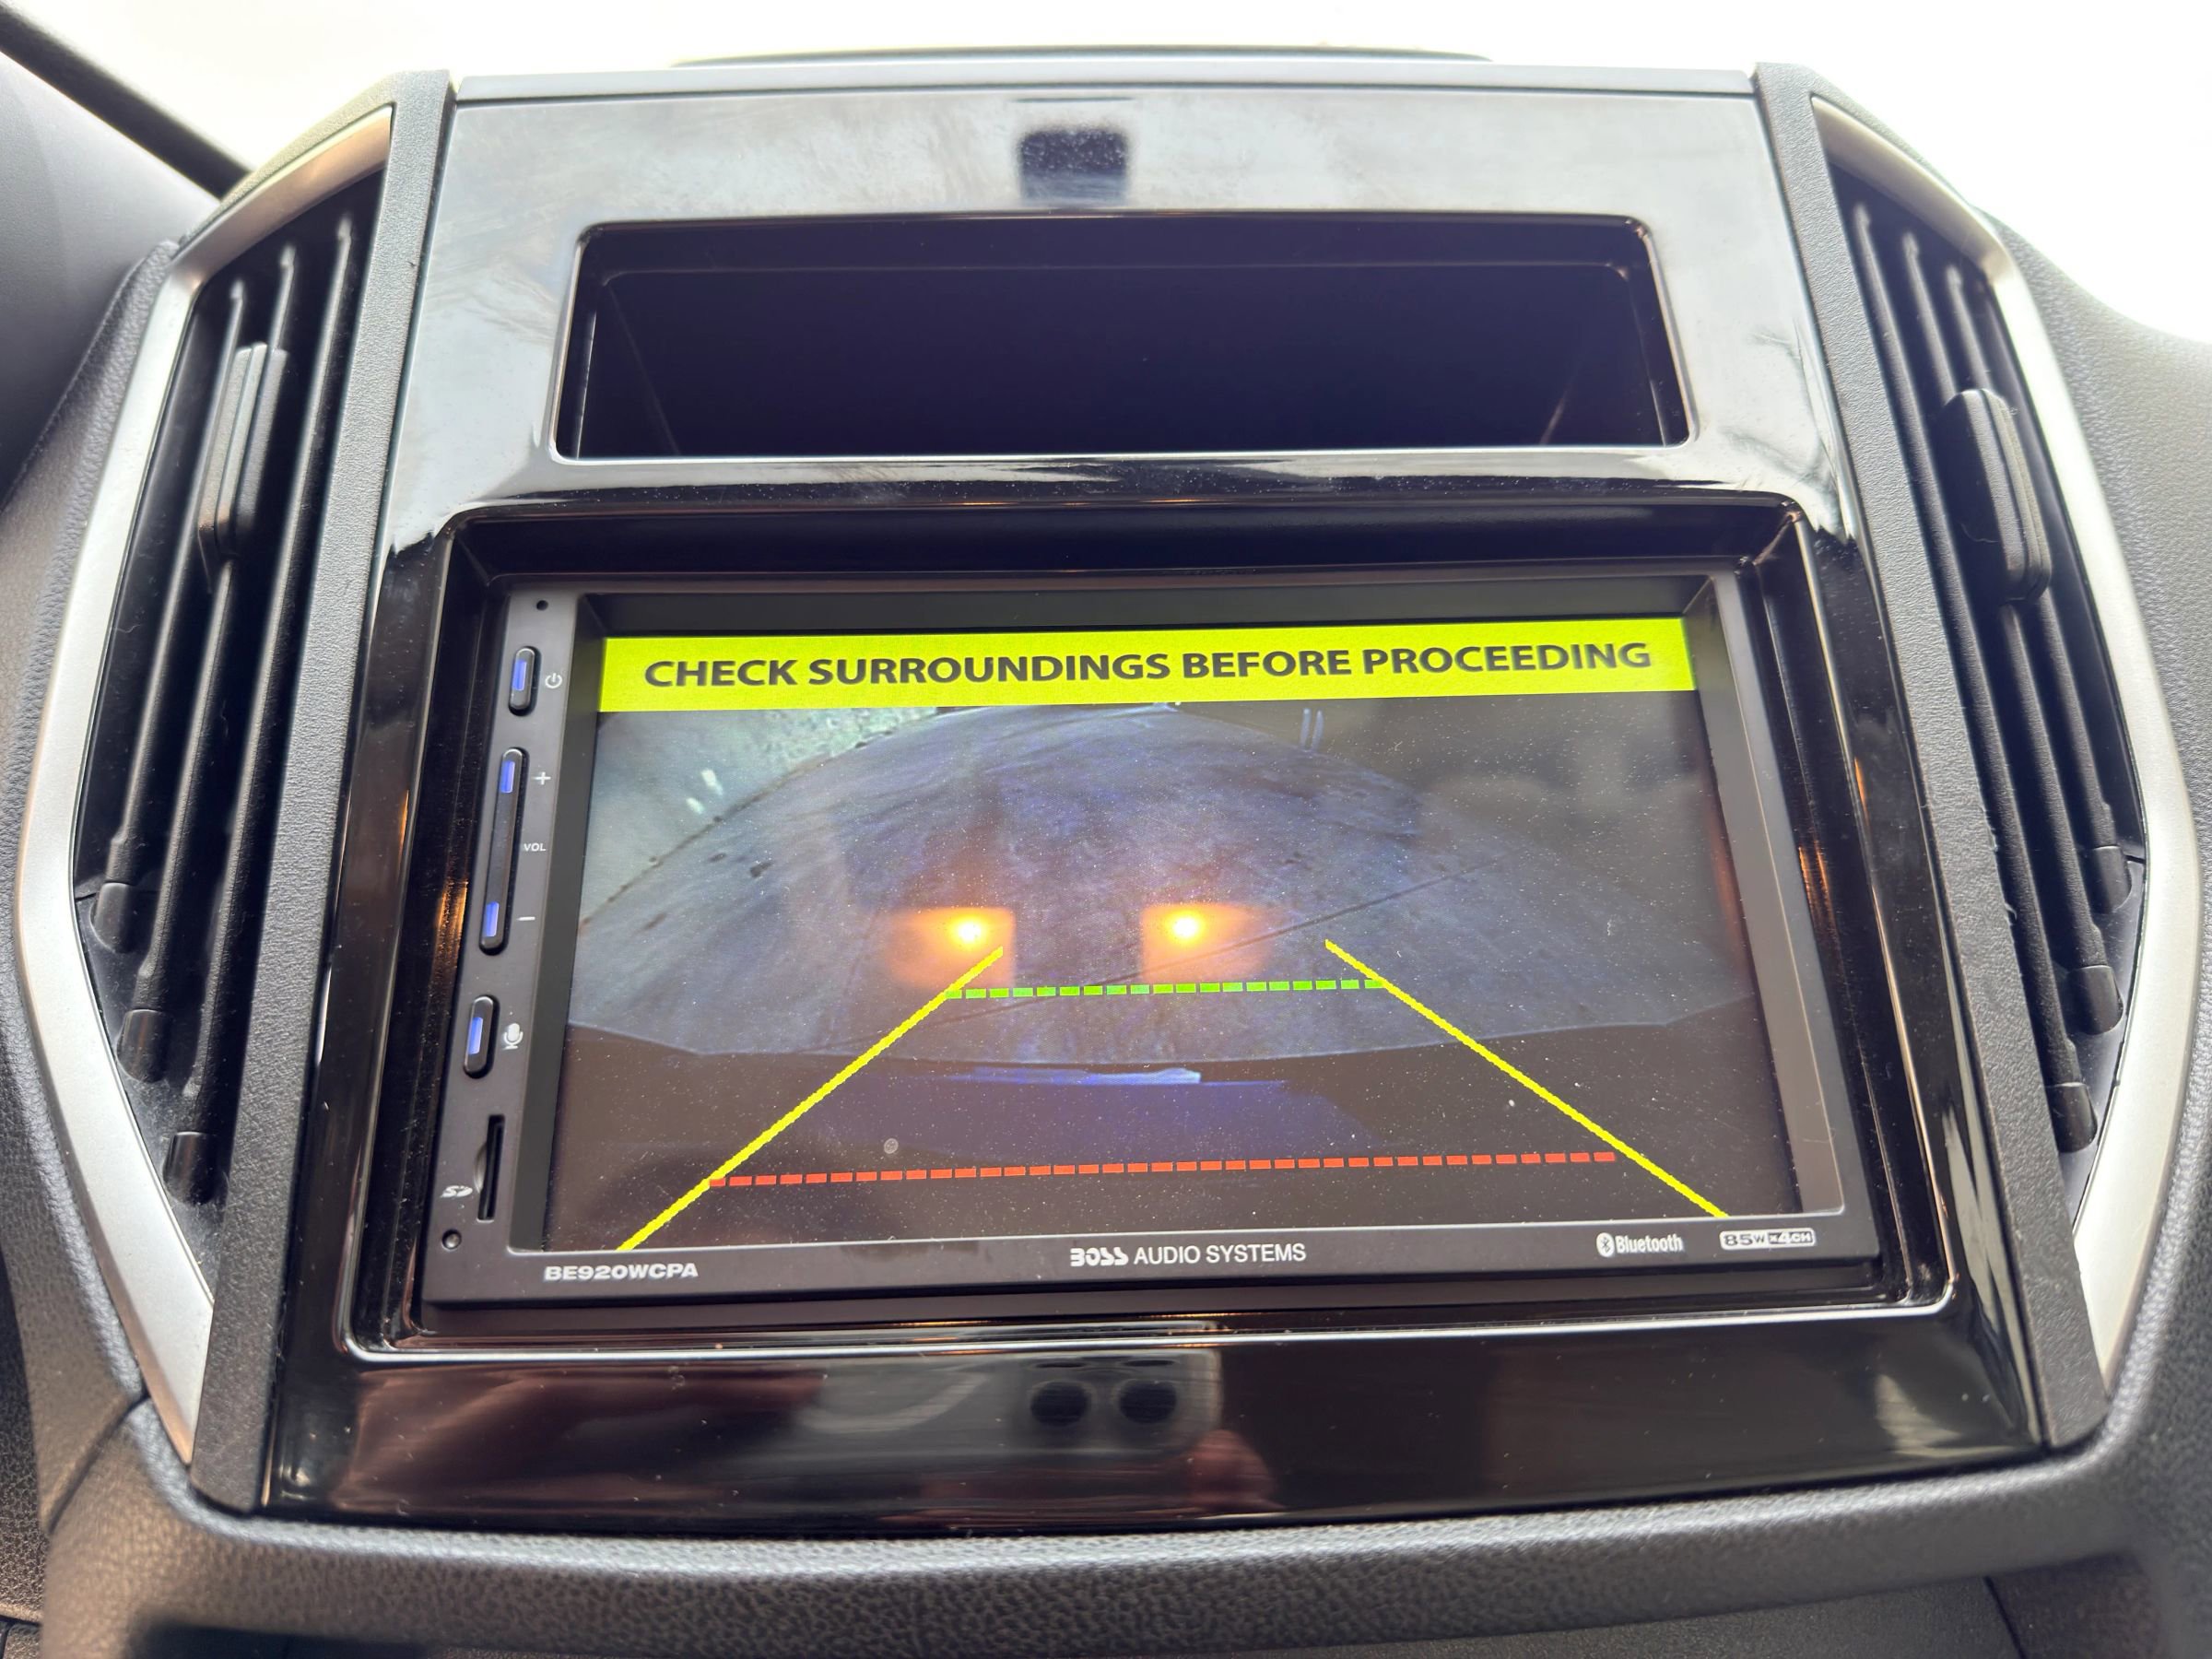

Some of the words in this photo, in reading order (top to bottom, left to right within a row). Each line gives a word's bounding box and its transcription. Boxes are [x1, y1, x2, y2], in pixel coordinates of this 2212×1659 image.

[644, 658, 798, 687] CHECK
[807, 653, 1171, 686] SURROUNDINGS
[1182, 650, 1352, 678] BEFORE
[1362, 642, 1652, 675] PROCEEDING
[524, 842, 547, 852] VOL
[1615, 1233, 1685, 1254] Bluetooth
[1070, 1246, 1129, 1267] BOSS
[1133, 1245, 1201, 1265] AUDIO
[1206, 1242, 1307, 1264] SYSTEMS
[543, 1263, 700, 1281] BE920WCPA
